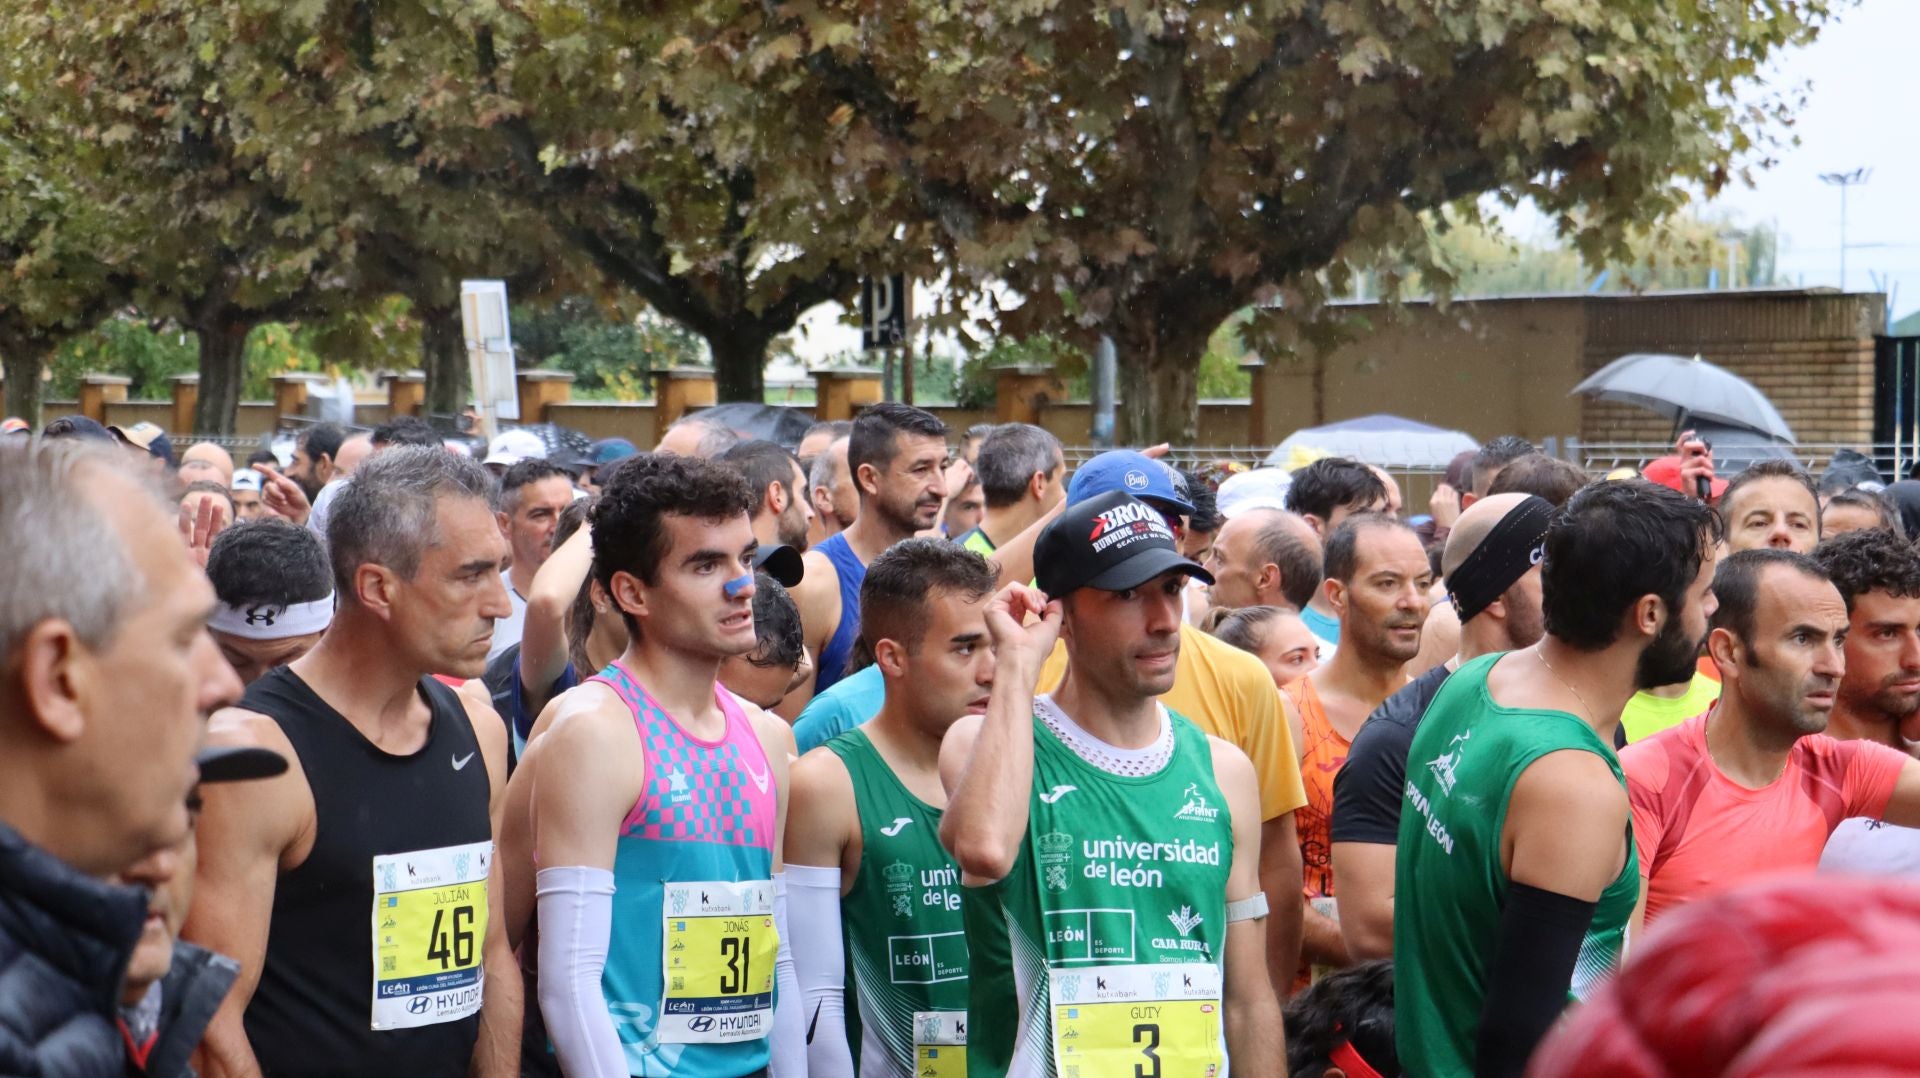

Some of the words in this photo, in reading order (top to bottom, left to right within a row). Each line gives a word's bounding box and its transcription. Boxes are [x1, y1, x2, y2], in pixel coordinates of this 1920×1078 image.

[871, 273, 893, 342] P
[1128, 473, 1146, 487] Buff
[1092, 526, 1134, 553] RUNNING
[1116, 532, 1149, 549] SEATTLE
[1083, 835, 1219, 866] universidad
[407, 862, 417, 877] k
[1083, 860, 1108, 878] de
[1110, 861, 1163, 888] león
[433, 887, 470, 905] JULIÁN
[701, 891, 709, 904] k
[923, 892, 942, 906] de
[723, 919, 750, 933] JONÁS
[1048, 925, 1084, 943] LEÓN
[427, 905, 474, 970] 46
[1151, 938, 1178, 950] CAJA
[1180, 939, 1210, 953] RURA
[720, 937, 750, 995] 31
[895, 950, 931, 966] LEÓN
[937, 966, 963, 976] DEPORTE
[1096, 976, 1107, 990] k
[1183, 973, 1192, 988] k
[1096, 990, 1138, 999] kutxabank
[1130, 1006, 1162, 1020] GUTY
[720, 1013, 761, 1031] HYUNDAI
[956, 1020, 965, 1033] k
[1132, 1023, 1161, 1078] 3
